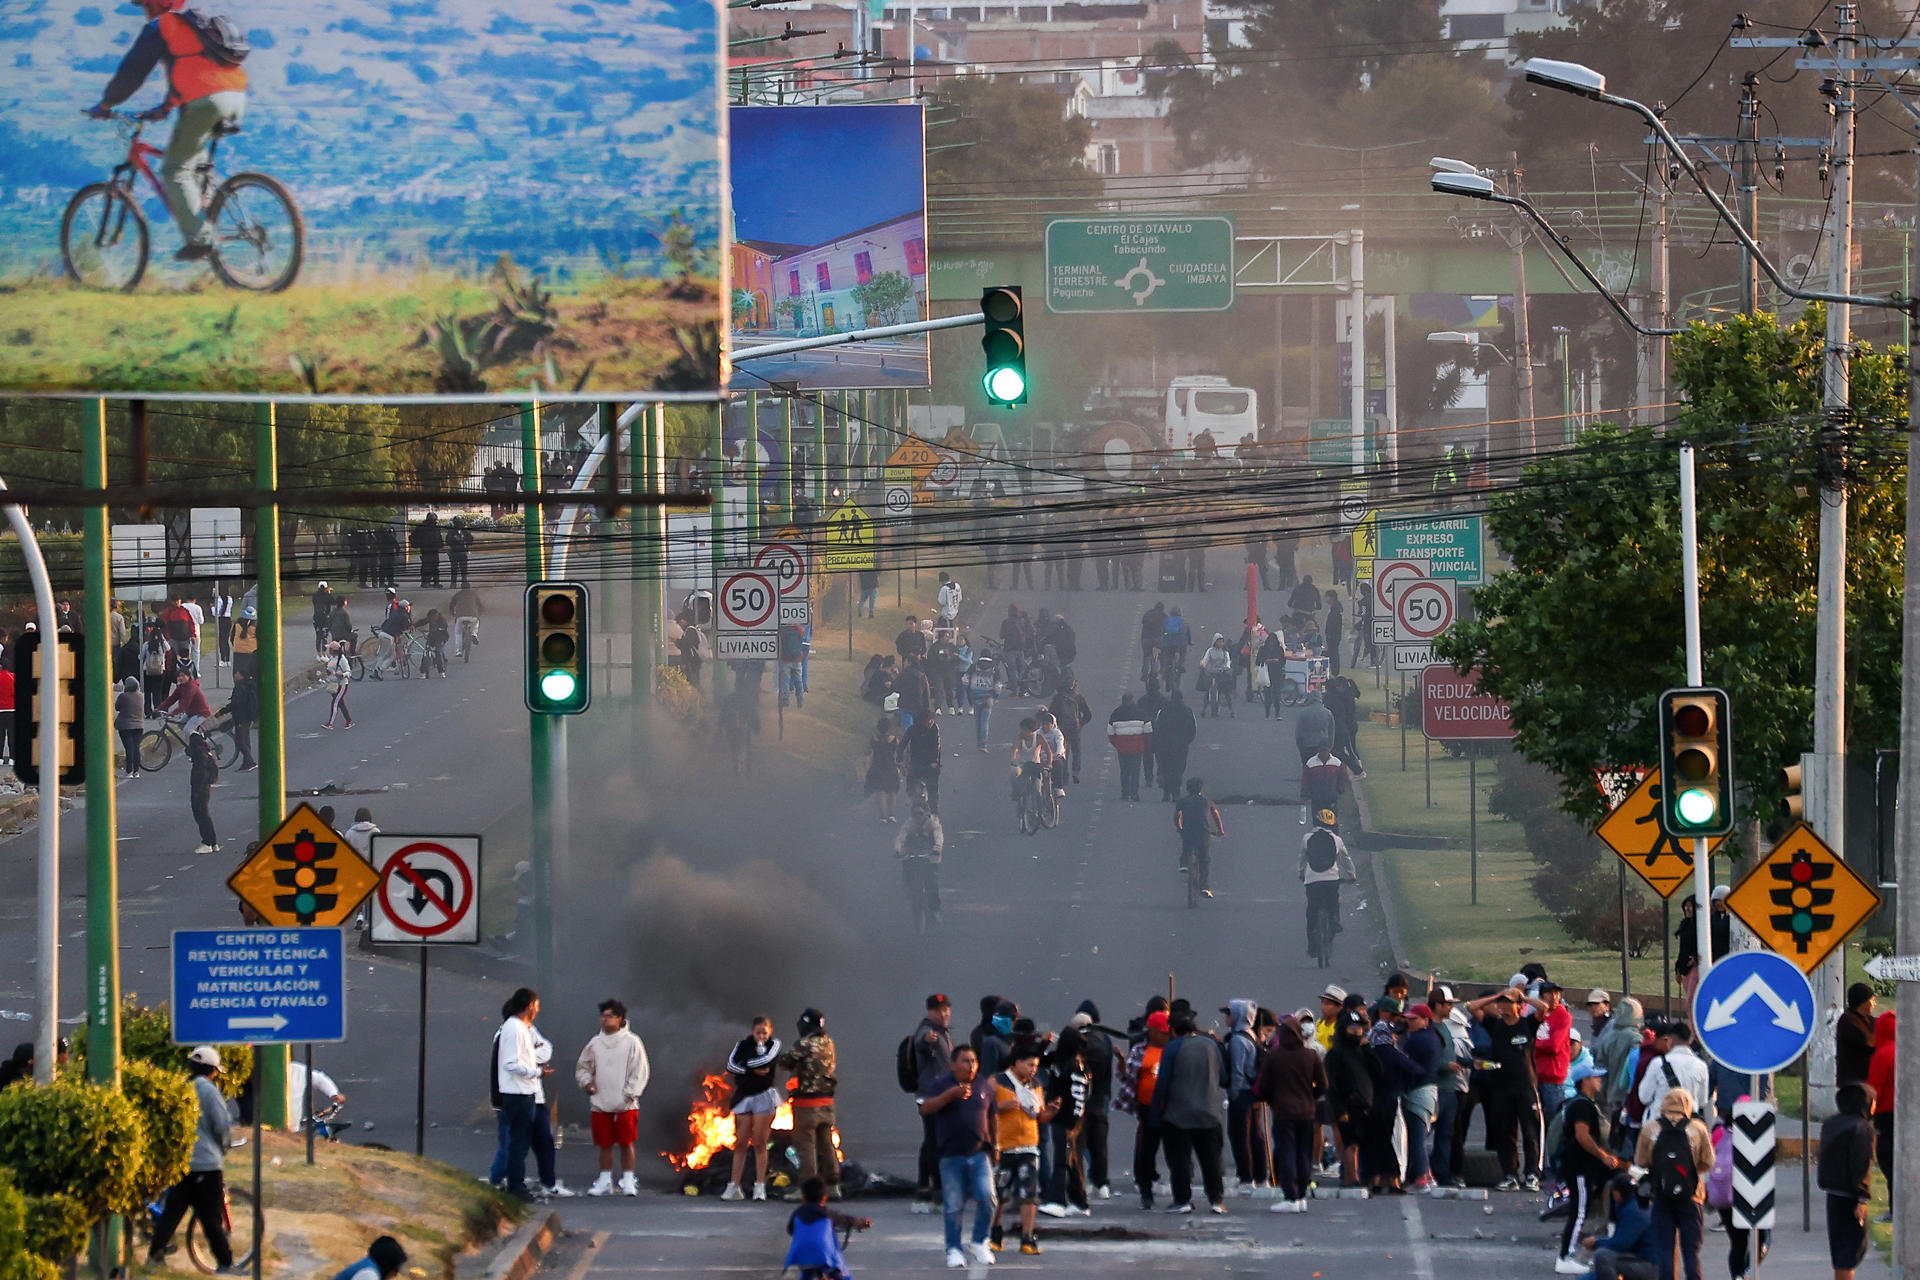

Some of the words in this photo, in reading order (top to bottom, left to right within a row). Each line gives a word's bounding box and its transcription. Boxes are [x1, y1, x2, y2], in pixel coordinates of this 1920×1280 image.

[1087, 225, 1126, 234] CENTRO
[1130, 224, 1142, 233] DE
[1145, 223, 1192, 233] OTAVALO
[1121, 235, 1130, 244] El
[1113, 245, 1166, 254] Tabacundo
[1053, 265, 1102, 275] TERMINAL
[1169, 264, 1226, 273] CIUDADELA
[1053, 276, 1109, 286] TERRESTRE
[1187, 274, 1226, 284] IMBAYA
[1053, 287, 1095, 299] Peguche
[890, 495, 907, 505] 30
[1391, 521, 1412, 531] USO
[1416, 521, 1428, 530] DE
[1431, 520, 1469, 530] CARRIL
[1406, 534, 1454, 544] EXPRESO
[1396, 548, 1465, 558] TRANSPORTE
[732, 588, 765, 611] 50
[783, 608, 806, 619] DOS
[1409, 598, 1442, 621] 50
[719, 641, 776, 653] LIVIANOS
[1434, 705, 1511, 720] VELOCIDAD
[216, 934, 276, 945] CENTRO
[281, 934, 299, 944] DE
[188, 948, 259, 962] REVISIÓN
[264, 948, 328, 960] TÉCNICA
[208, 965, 294, 977] VEHICULAR
[298, 965, 308, 975] Y
[197, 979, 320, 993] MATRICULACIÓN
[189, 998, 256, 1009] AGENCIA
[261, 996, 328, 1008] OTAVALO
